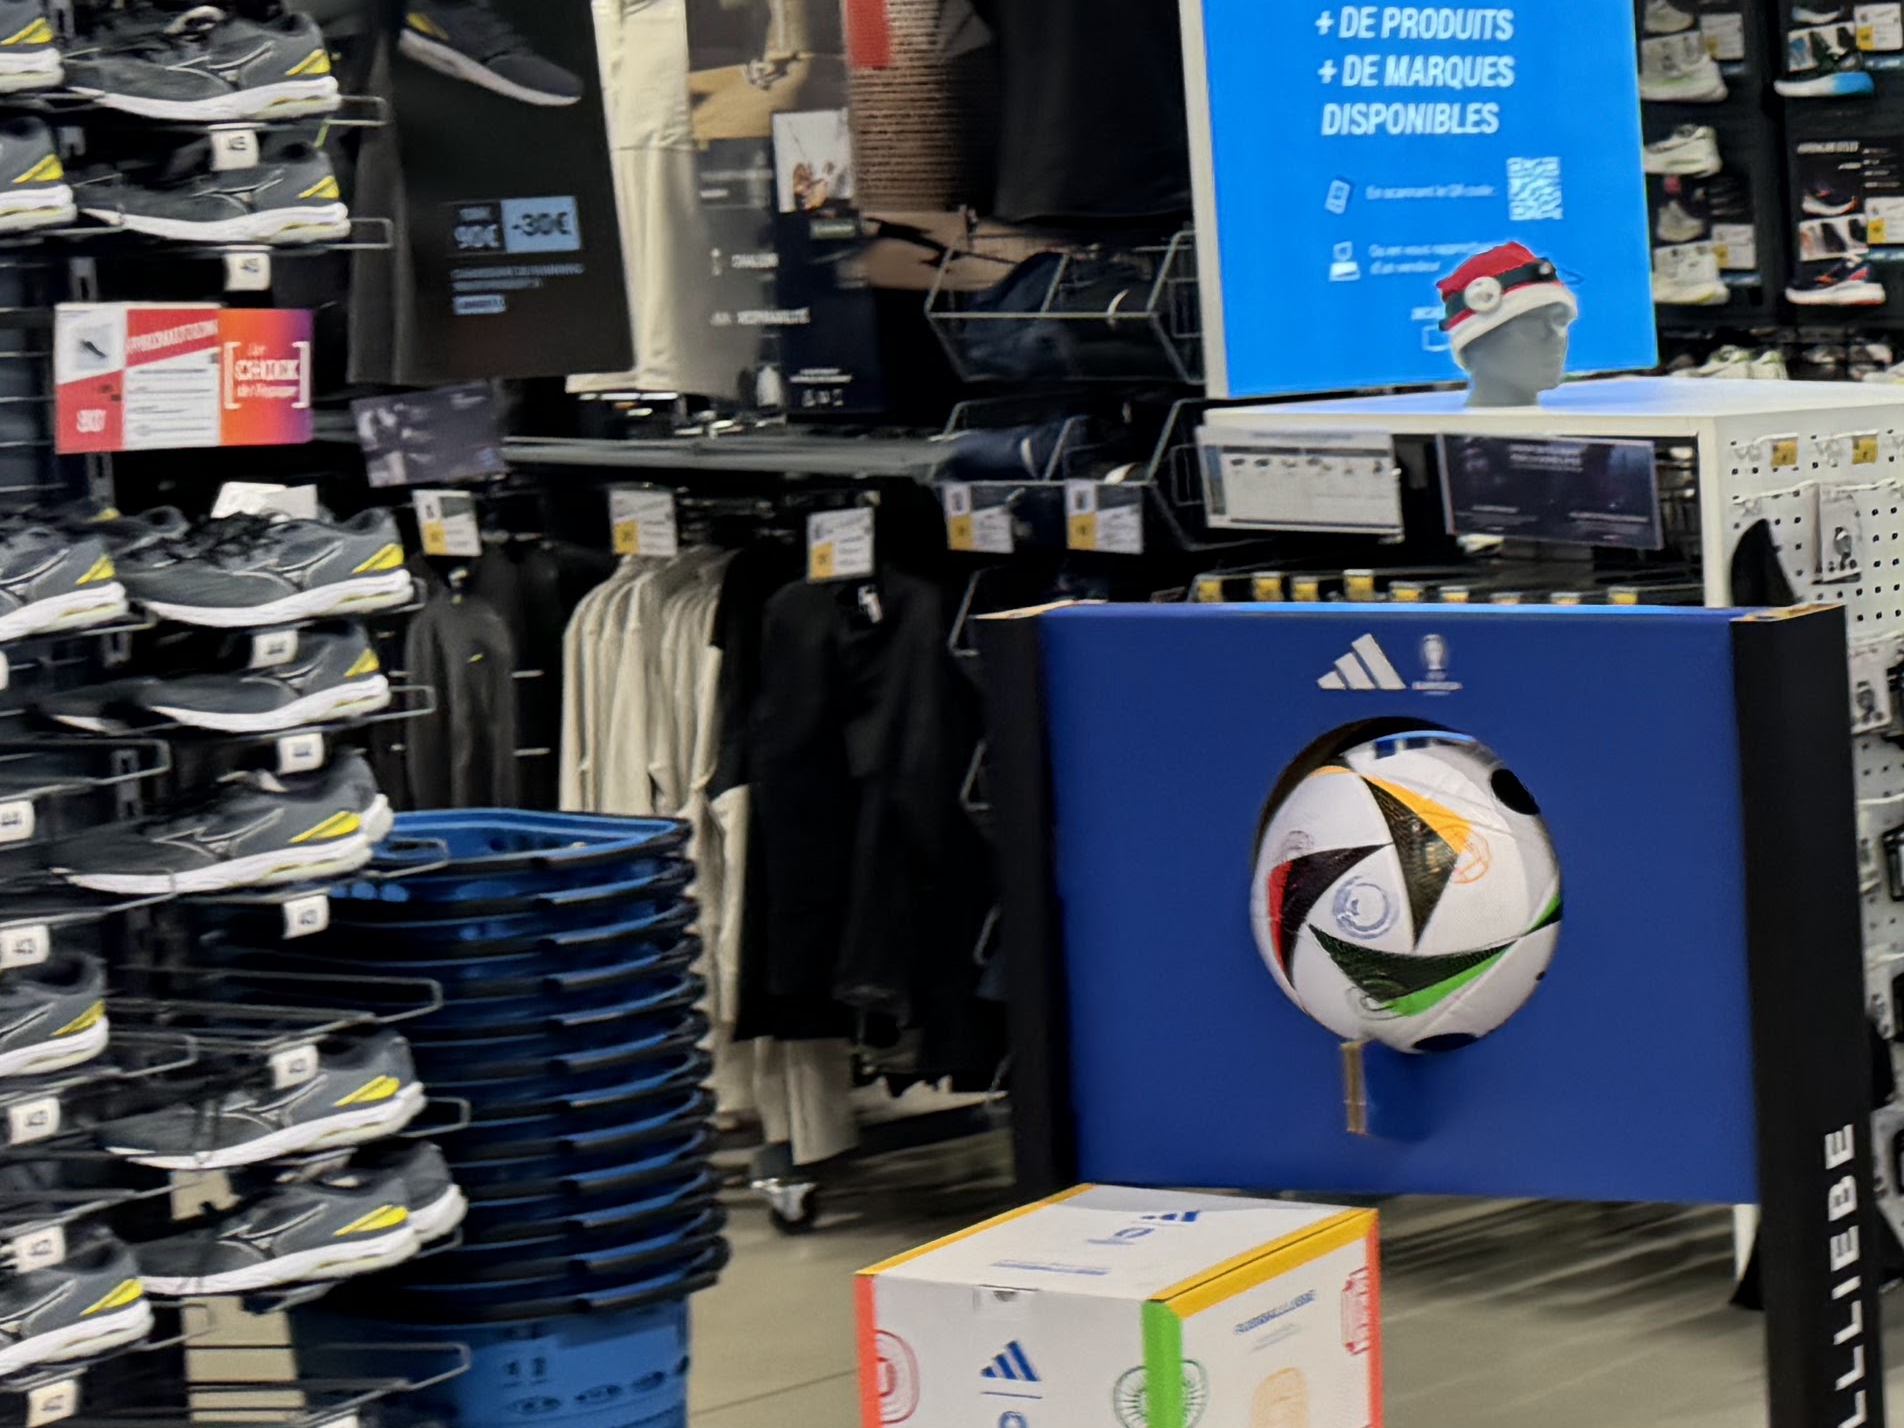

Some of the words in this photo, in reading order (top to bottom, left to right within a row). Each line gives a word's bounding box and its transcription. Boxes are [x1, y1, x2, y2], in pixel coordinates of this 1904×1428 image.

[1338, 6, 1377, 40] DE
[1381, 7, 1515, 42] PRODUITS
[1341, 54, 1379, 88] DE
[1384, 54, 1516, 91] MARQUES
[1321, 101, 1500, 136] DISPONIBLES
